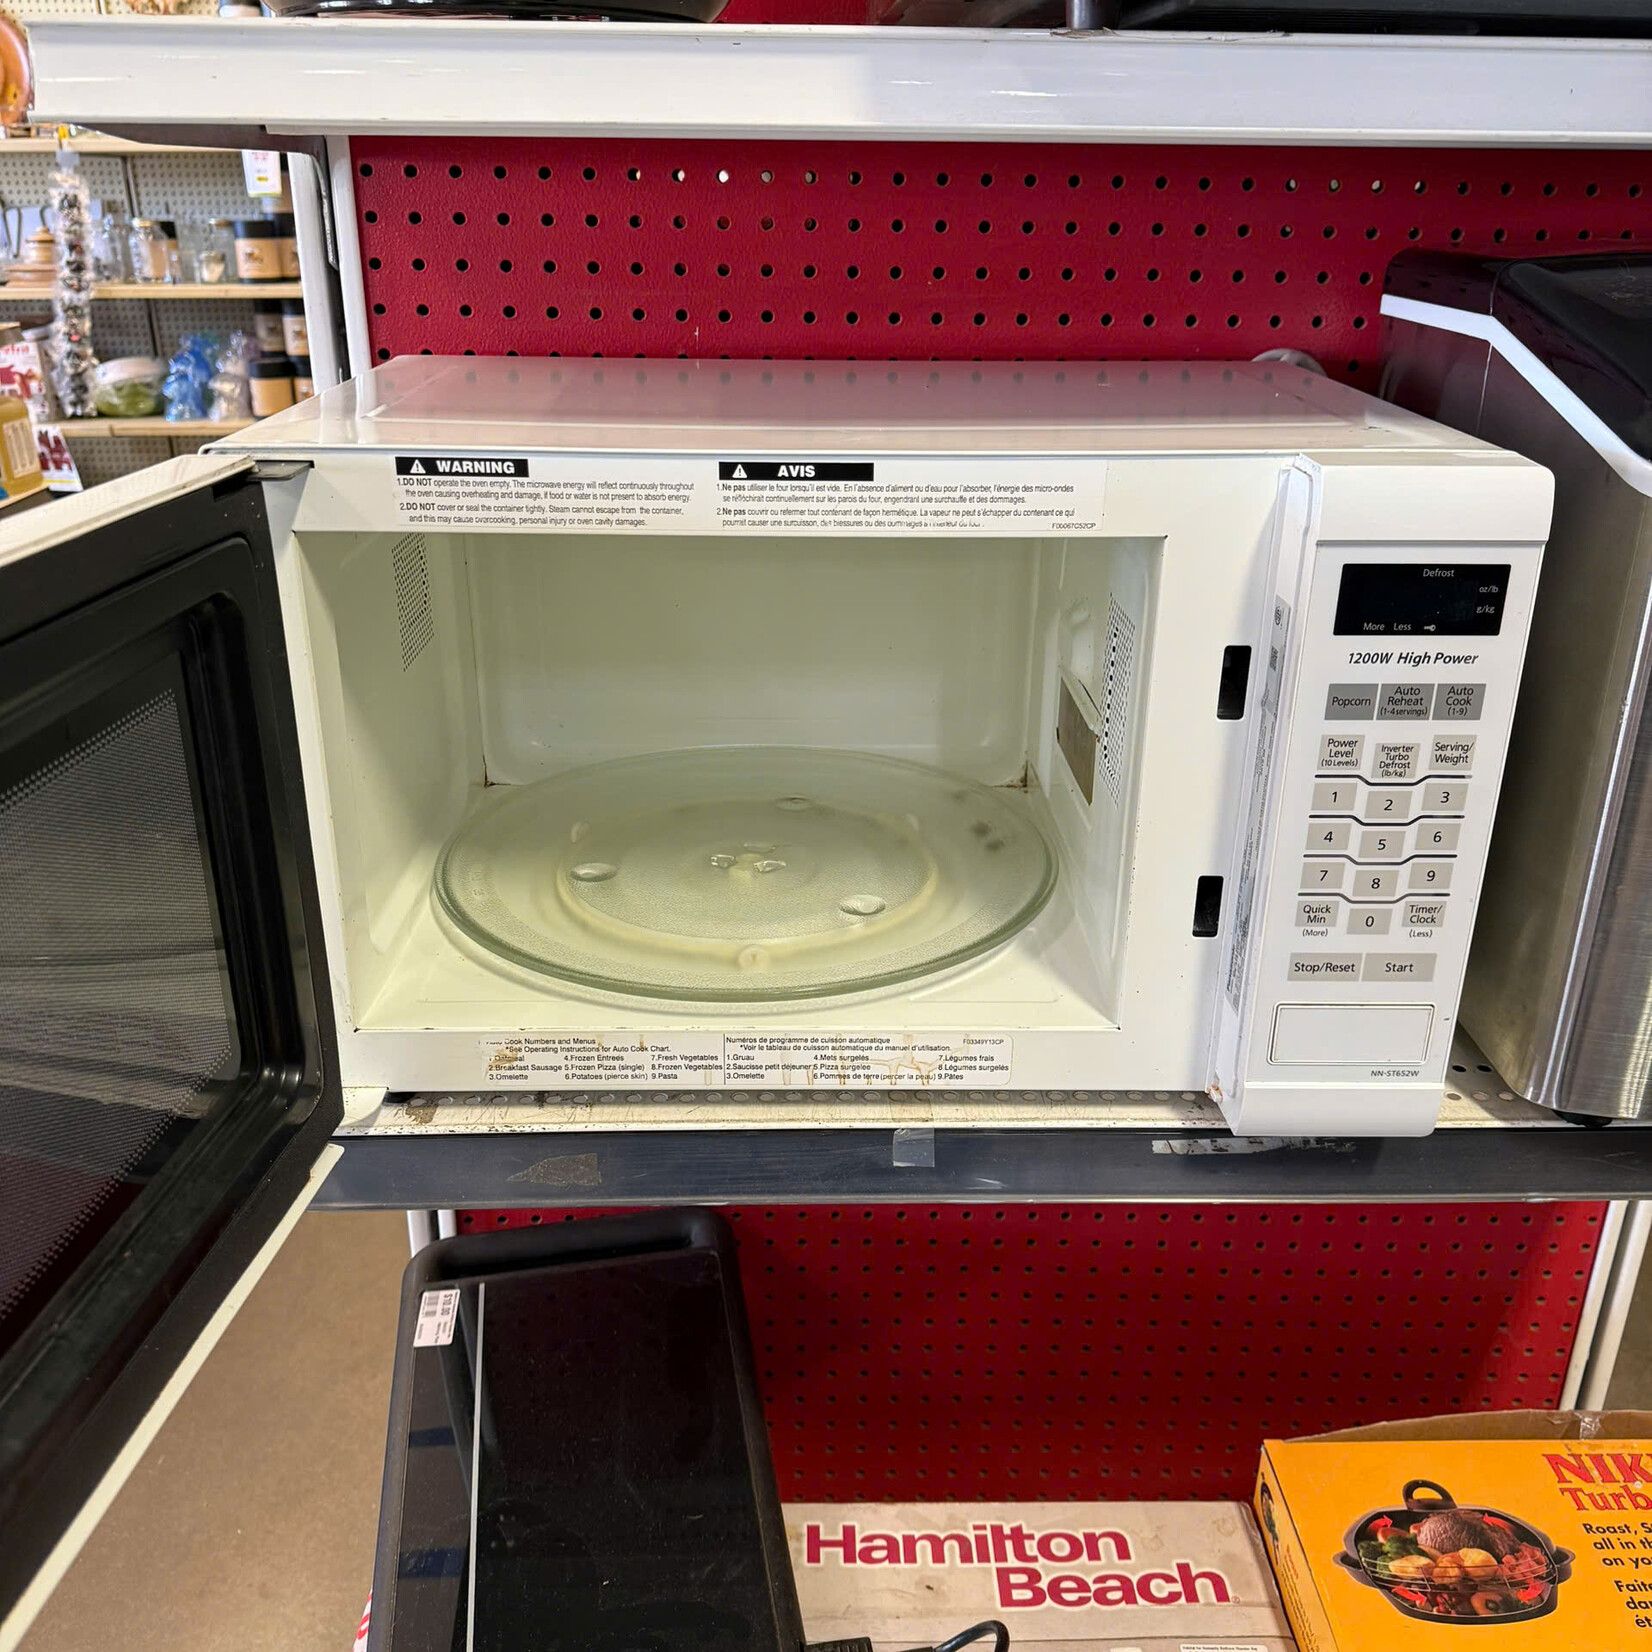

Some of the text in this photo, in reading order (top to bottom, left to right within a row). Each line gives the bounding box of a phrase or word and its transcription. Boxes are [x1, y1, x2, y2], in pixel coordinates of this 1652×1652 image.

[436, 461, 515, 474] WARNING
[778, 465, 815, 478] AVIS
[417, 478, 431, 486] NOT
[434, 480, 459, 488] operate
[489, 481, 511, 489] empty.
[513, 480, 524, 488] The
[527, 480, 560, 489] microwave
[563, 482, 585, 490] energy
[619, 482, 658, 492] continuously
[660, 482, 694, 492] throughout
[734, 485, 746, 493] pas
[769, 484, 774, 492] le
[844, 484, 853, 492] En
[406, 489, 416, 497] the
[435, 491, 460, 499] causing
[462, 491, 499, 500] overheating
[501, 491, 513, 499] and
[574, 492, 591, 500] water
[593, 492, 598, 500] is
[611, 493, 635, 501] present
[668, 495, 691, 503] energy.
[838, 496, 857, 504] parois
[420, 503, 435, 511] NOT
[481, 504, 492, 512] the
[549, 505, 570, 513] Steam
[621, 506, 636, 514] from
[854, 508, 861, 516] de
[437, 516, 451, 524] may
[549, 517, 567, 526] injury
[595, 518, 613, 527] cavity
[1423, 568, 1454, 577] Defrost
[1476, 606, 1495, 614] g/kg
[1364, 623, 1385, 631] More
[1394, 623, 1411, 631] Less
[1349, 652, 1478, 667] 1200W High Power
[1394, 686, 1420, 695] Auto
[1448, 686, 1474, 695] Auto
[1332, 696, 1371, 708] Popcorn
[1388, 696, 1423, 706] Reheat
[1446, 696, 1472, 706] Cook
[1448, 707, 1467, 716] (1-9)
[1328, 738, 1358, 749] Power
[1435, 742, 1473, 752] Serving/
[1329, 749, 1353, 758] Level
[1385, 753, 1409, 761] Turbo
[1322, 759, 1358, 767] (10 Levels)
[1435, 754, 1468, 765] Weight
[1379, 761, 1410, 769] Defrost
[1382, 770, 1406, 778] (lb/kg)
[1332, 792, 1338, 802] 1
[1440, 792, 1450, 803] 3
[1384, 799, 1393, 811] 2
[1324, 831, 1333, 842] 4
[1433, 831, 1442, 842] 6
[1377, 839, 1386, 850] 5
[1320, 870, 1328, 881] 7
[1426, 870, 1435, 881] 9
[1371, 878, 1380, 889] 8
[1303, 905, 1331, 915] Quick
[1409, 905, 1442, 913] Timer/
[1307, 915, 1326, 923] Min
[1365, 916, 1374, 927] 0
[1410, 915, 1436, 923] Clock
[1302, 929, 1328, 937] (More)
[1409, 929, 1433, 938] (Less)
[1295, 962, 1355, 973] Stop/Reset
[1385, 962, 1413, 972] Start
[524, 1046, 558, 1054] Operating
[1542, 1453, 1652, 1483] NIK
[1583, 1523, 1652, 1535] Roast, S
[806, 1524, 1132, 1565] Hamilton
[1593, 1538, 1614, 1550] all
[1618, 1541, 1636, 1549] in
[1602, 1557, 1652, 1569] on yo
[995, 1562, 1231, 1608] Beach
